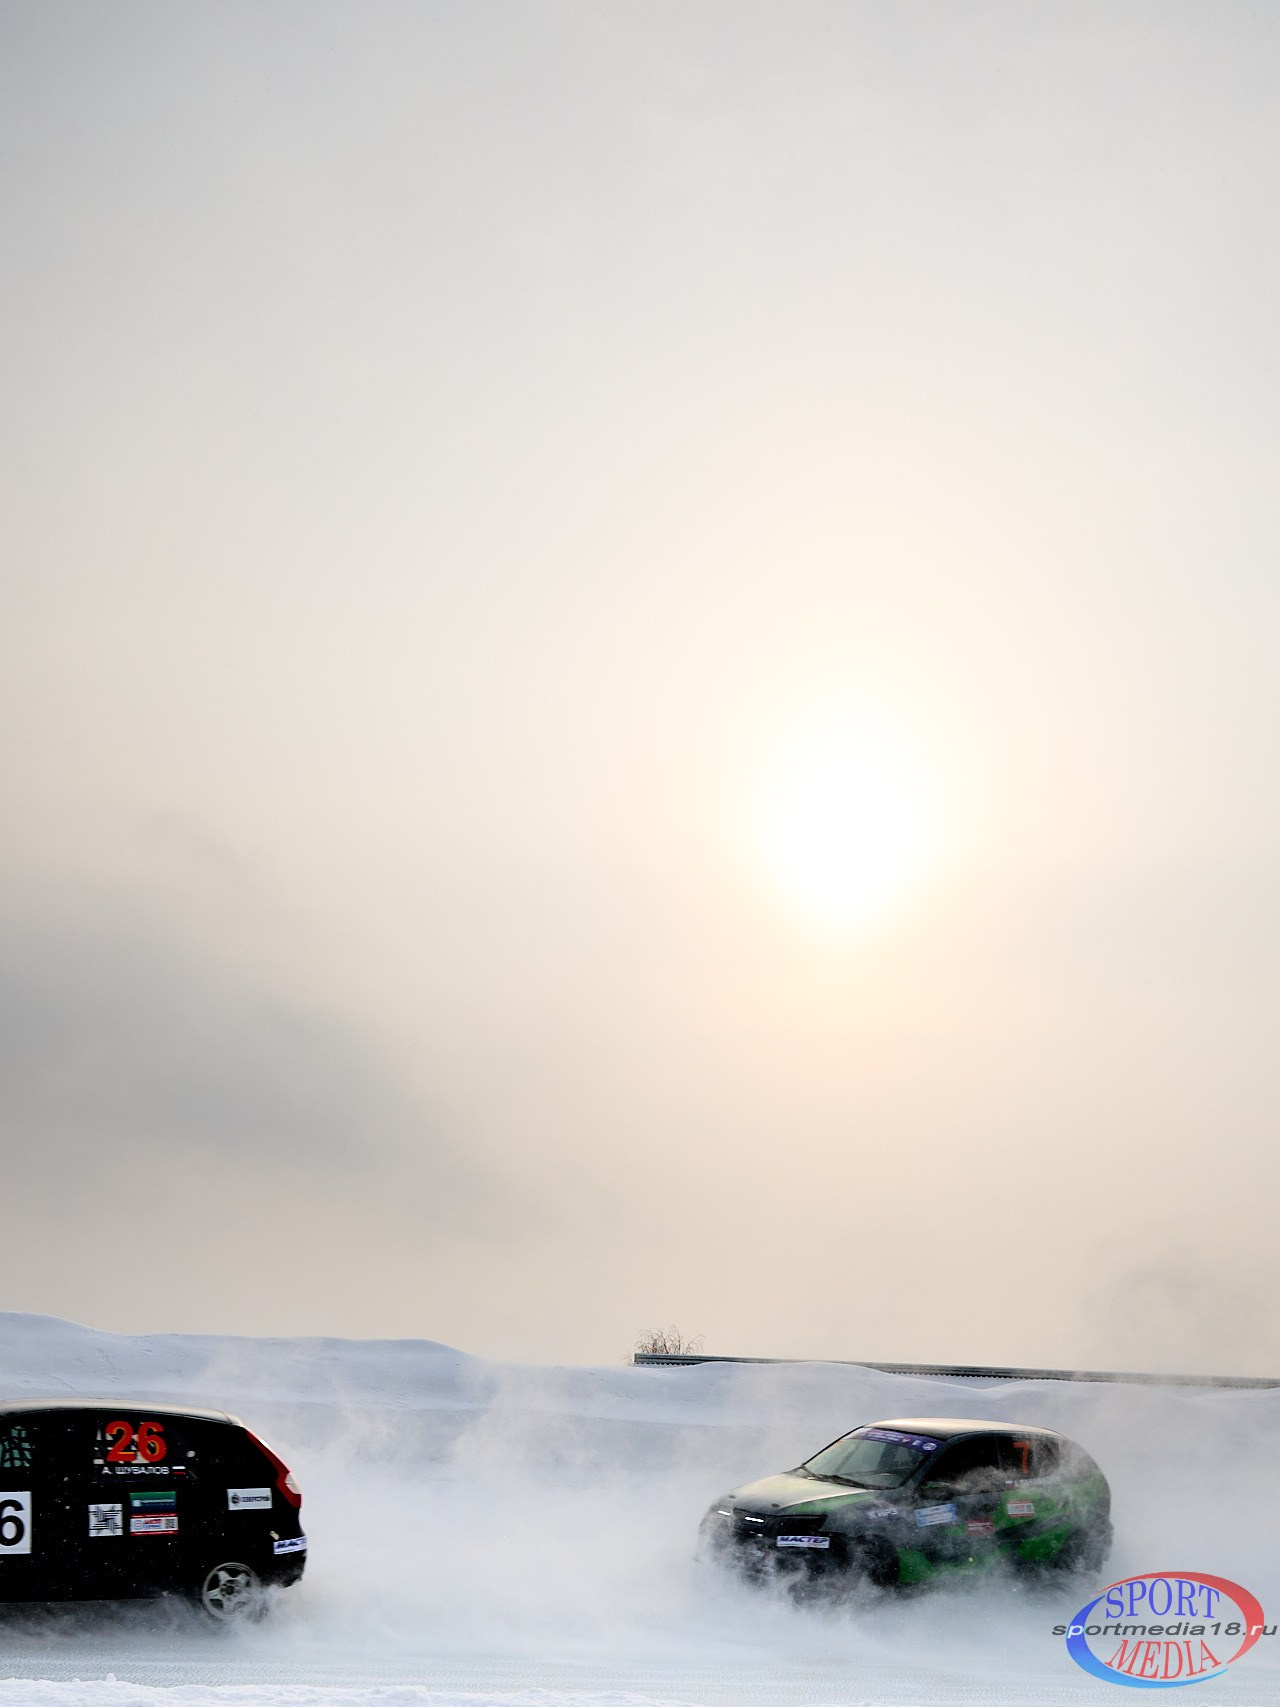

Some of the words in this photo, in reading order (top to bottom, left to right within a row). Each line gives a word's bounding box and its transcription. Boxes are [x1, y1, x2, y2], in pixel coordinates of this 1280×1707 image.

[105, 1420, 168, 1463] 26
[115, 1466, 170, 1475] ШУВАЛОВ
[779, 1535, 829, 1545] МАСТЕР
